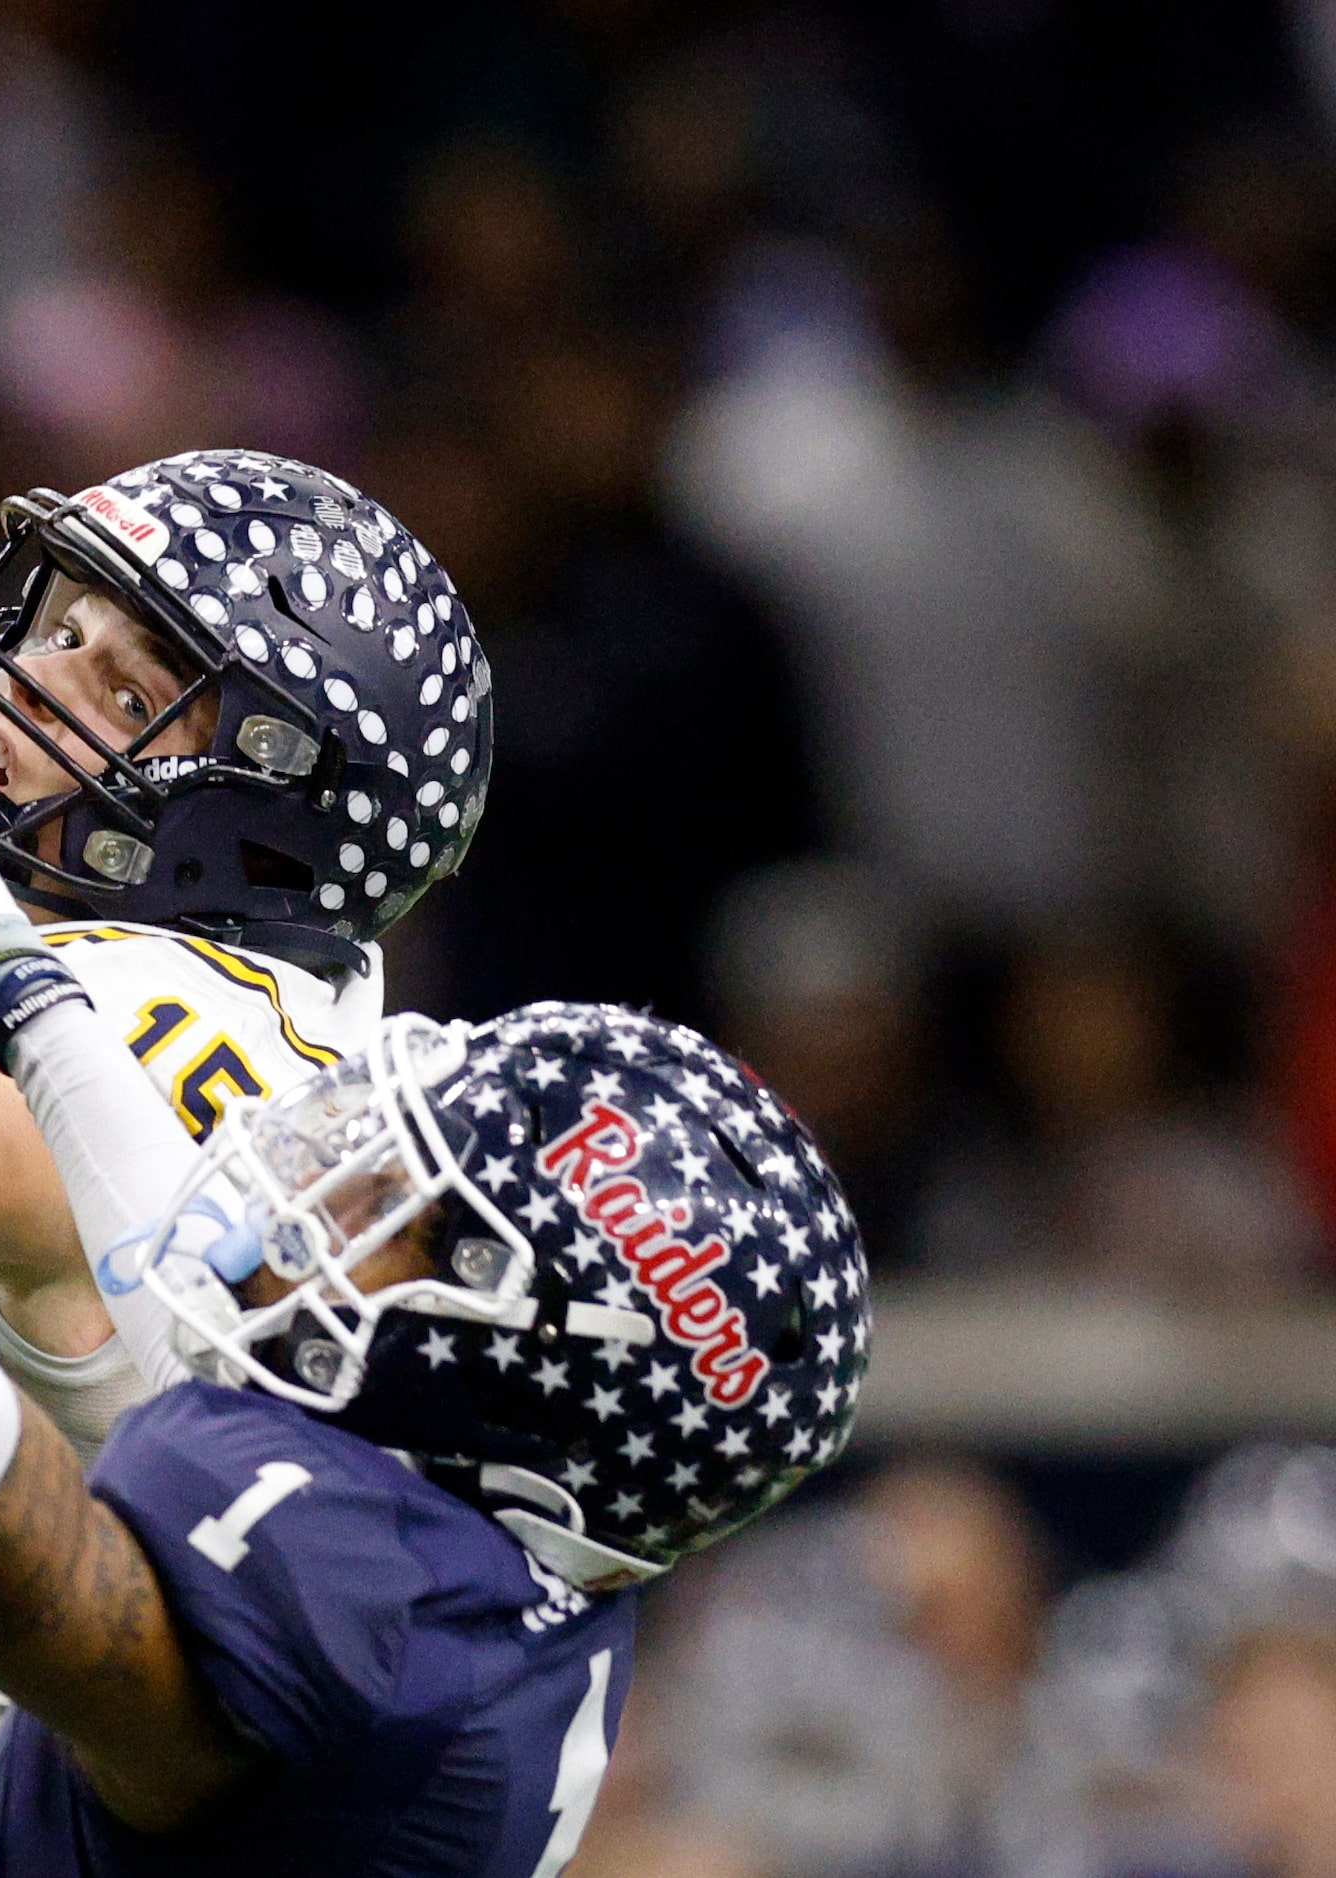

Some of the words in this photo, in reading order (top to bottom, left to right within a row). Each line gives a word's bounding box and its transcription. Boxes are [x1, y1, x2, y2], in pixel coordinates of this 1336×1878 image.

[313, 495, 345, 531] PRIDE
[538, 1101, 770, 1411] Raiders
[187, 1461, 313, 1572] 1
